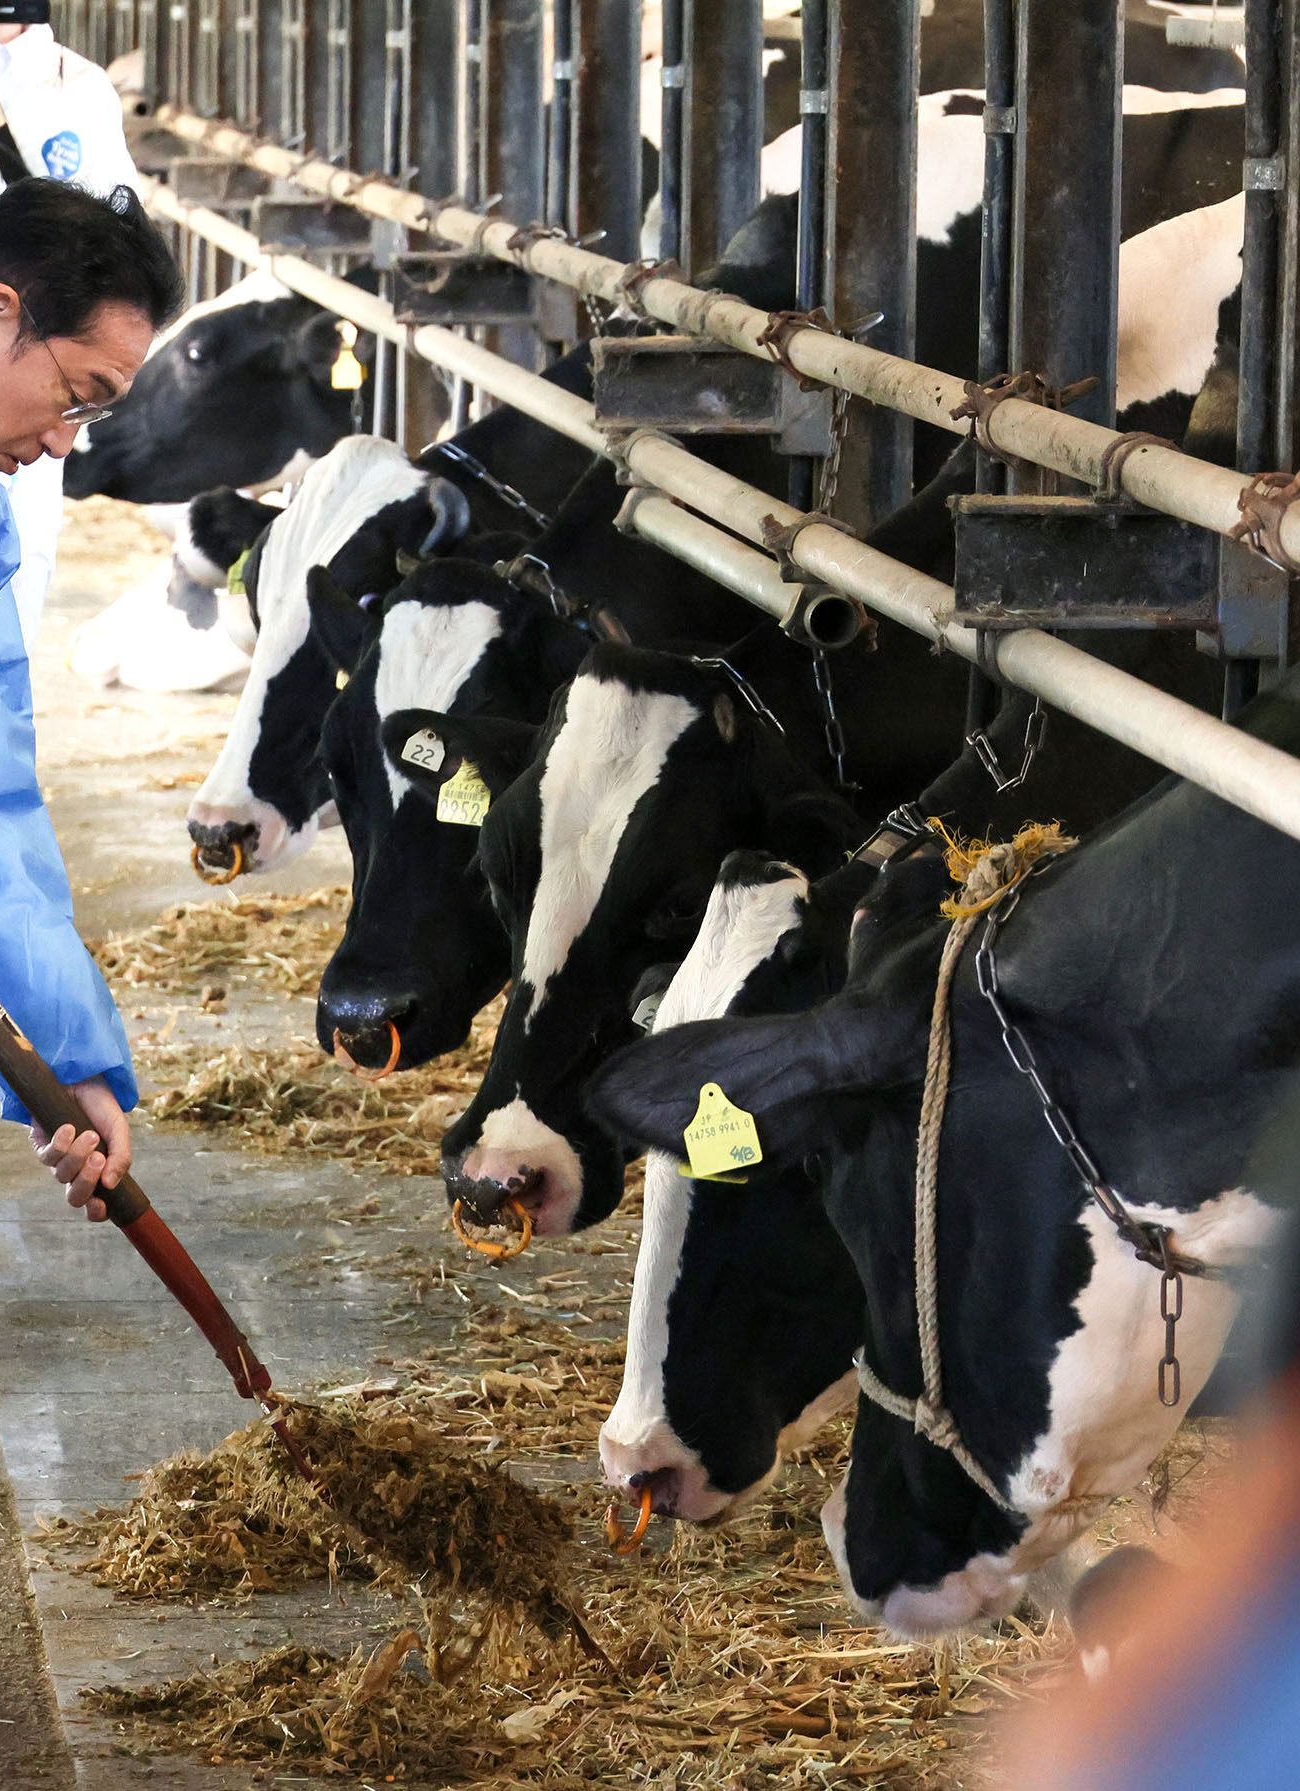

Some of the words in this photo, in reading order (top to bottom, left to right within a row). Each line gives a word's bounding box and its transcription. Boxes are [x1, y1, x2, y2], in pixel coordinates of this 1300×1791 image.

[410, 744, 435, 766] 22
[688, 1126, 716, 1142] 14758
[718, 1121, 741, 1135] 9941
[744, 1118, 751, 1129] 0
[701, 1114, 712, 1126] JP
